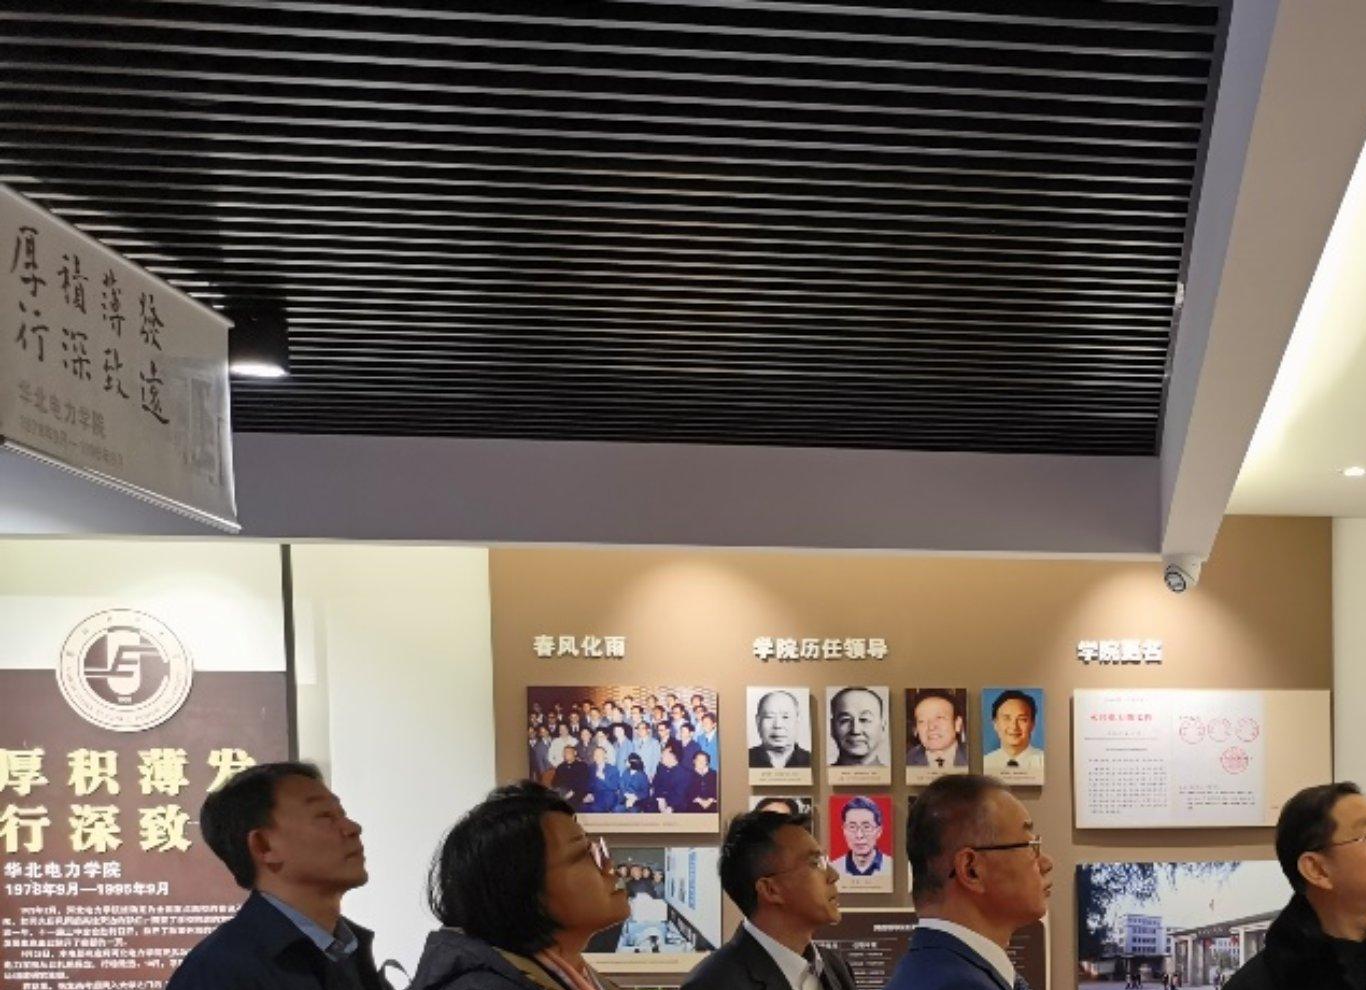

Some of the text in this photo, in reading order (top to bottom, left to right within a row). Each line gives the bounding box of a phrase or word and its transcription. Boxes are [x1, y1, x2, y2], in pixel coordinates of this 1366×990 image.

[532, 635, 627, 659] 春风化雨
[752, 637, 889, 661] 学院历任领导
[4, 861, 122, 879] 华北电力学院
